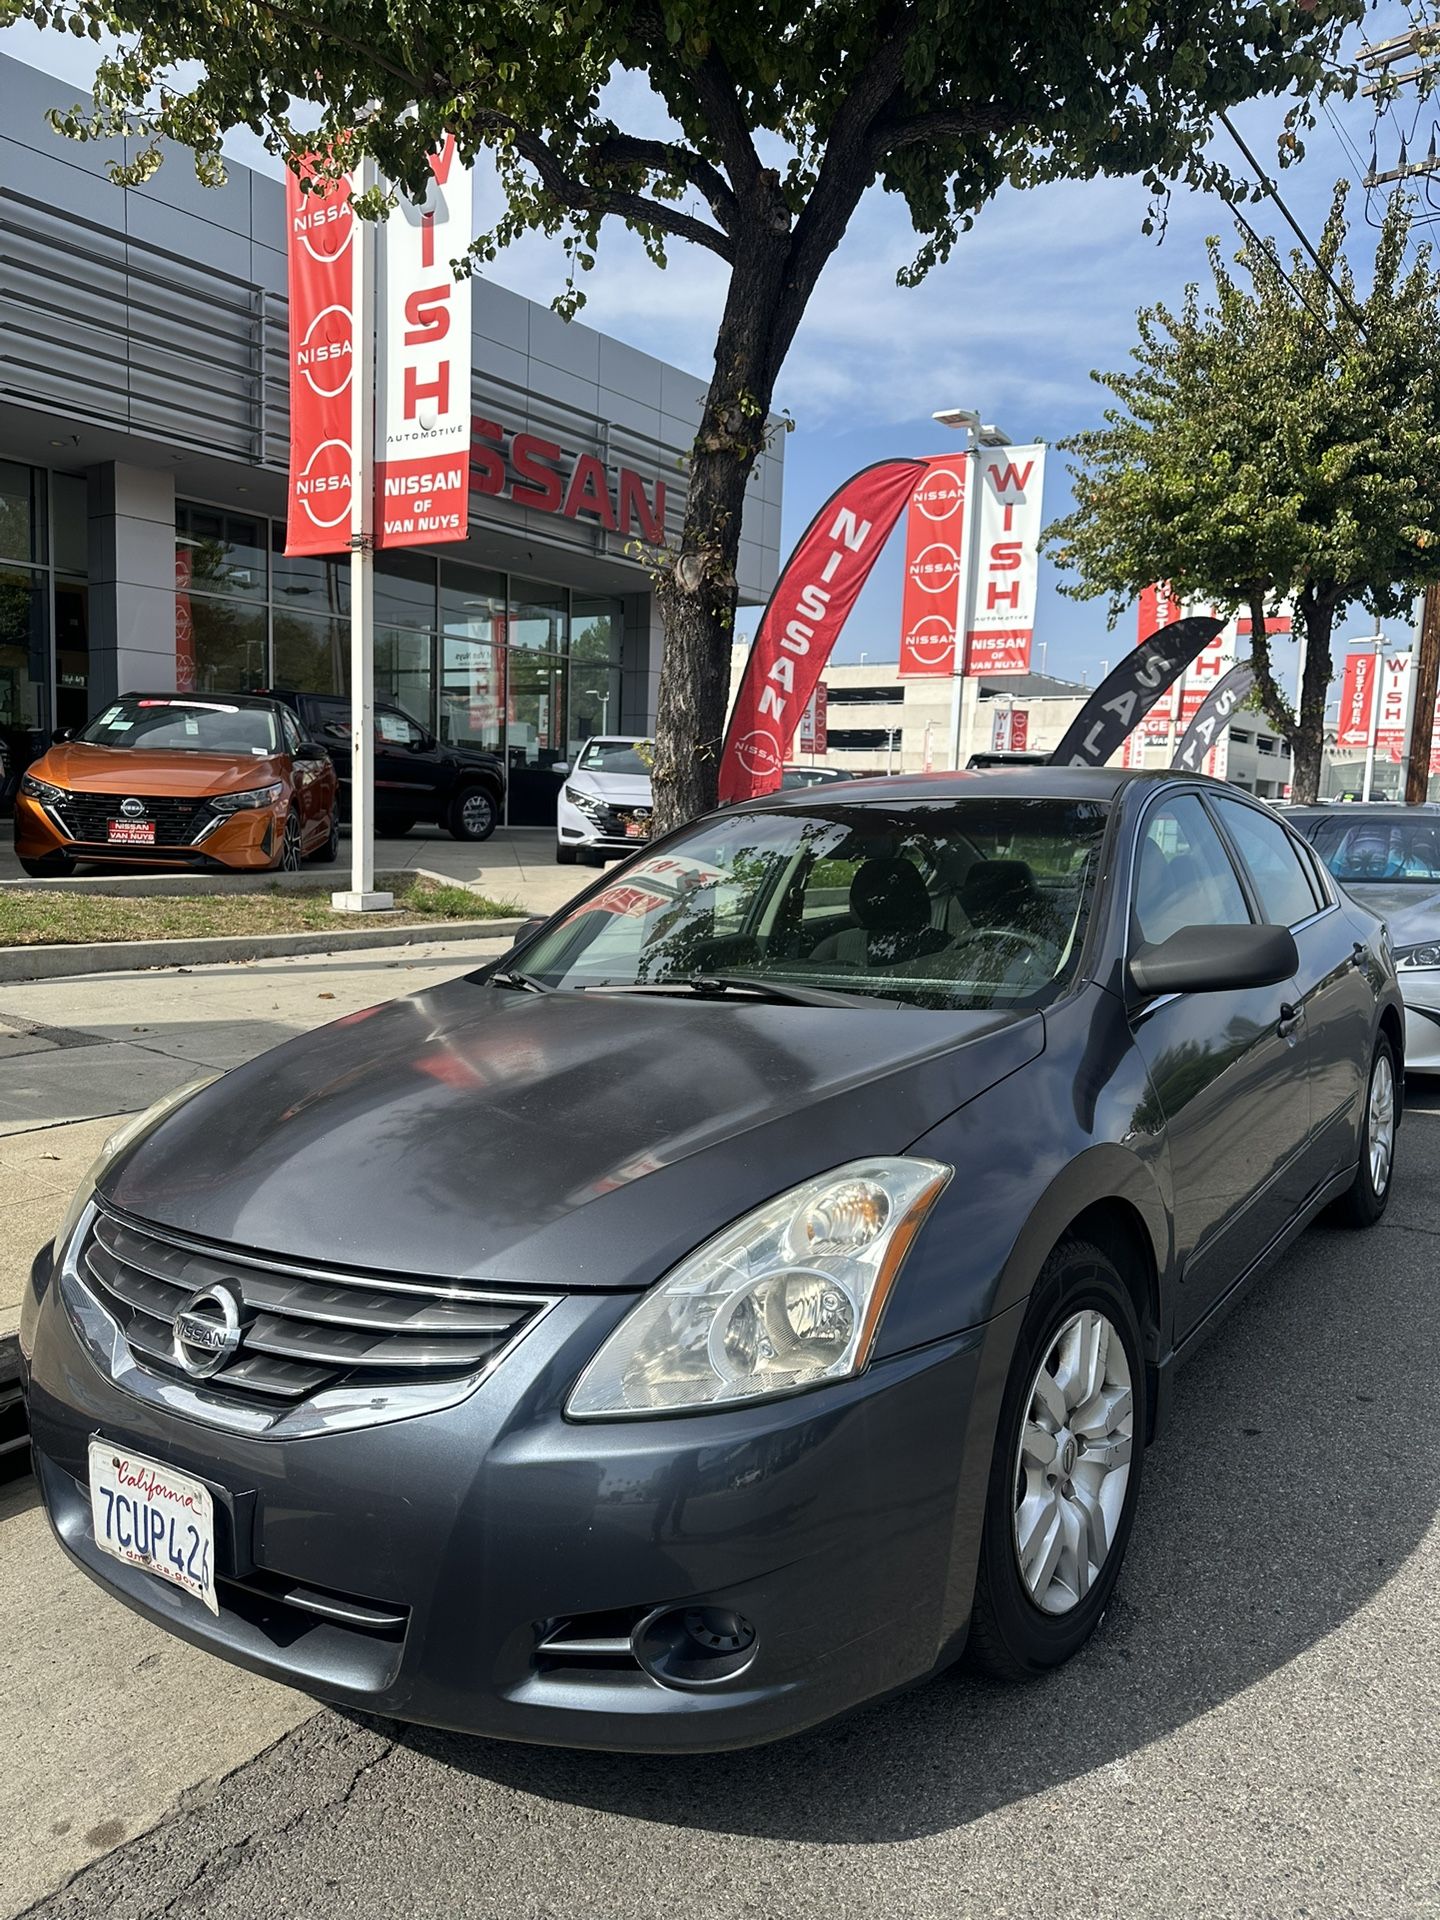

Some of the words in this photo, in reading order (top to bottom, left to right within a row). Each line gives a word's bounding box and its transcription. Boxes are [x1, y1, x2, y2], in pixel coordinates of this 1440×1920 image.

[294, 201, 351, 232] NISSA
[297, 340, 352, 366] NISSA
[386, 425, 463, 442] AUTOMOTIVE
[296, 475, 352, 495] NISSA
[385, 469, 462, 497] NISSAN
[470, 415, 666, 545] SSAN
[414, 500, 432, 513] OF
[913, 489, 966, 502] NISSAN
[384, 519, 414, 535] VAN
[418, 514, 459, 532] NUYS
[987, 461, 1034, 610] WISH
[909, 563, 961, 575] NISSAN
[758, 507, 872, 725] NISSAN
[971, 637, 1027, 650] NISSAN
[991, 651, 1005, 660] OF
[970, 661, 992, 670] VAN
[994, 660, 1025, 669] NUYS
[1351, 659, 1367, 725] CUSTOMER
[1385, 659, 1409, 720] WISH
[1180, 688, 1237, 771] SAL
[735, 742, 781, 768] NISSAN
[114, 823, 149, 831] NISSAN
[130, 832, 154, 840] NUYS
[174, 1319, 227, 1347] NISSAN
[118, 1460, 202, 1516] California
[100, 1486, 210, 1592] 7CUP426
[126, 1550, 196, 1588] dm.ca.gov
